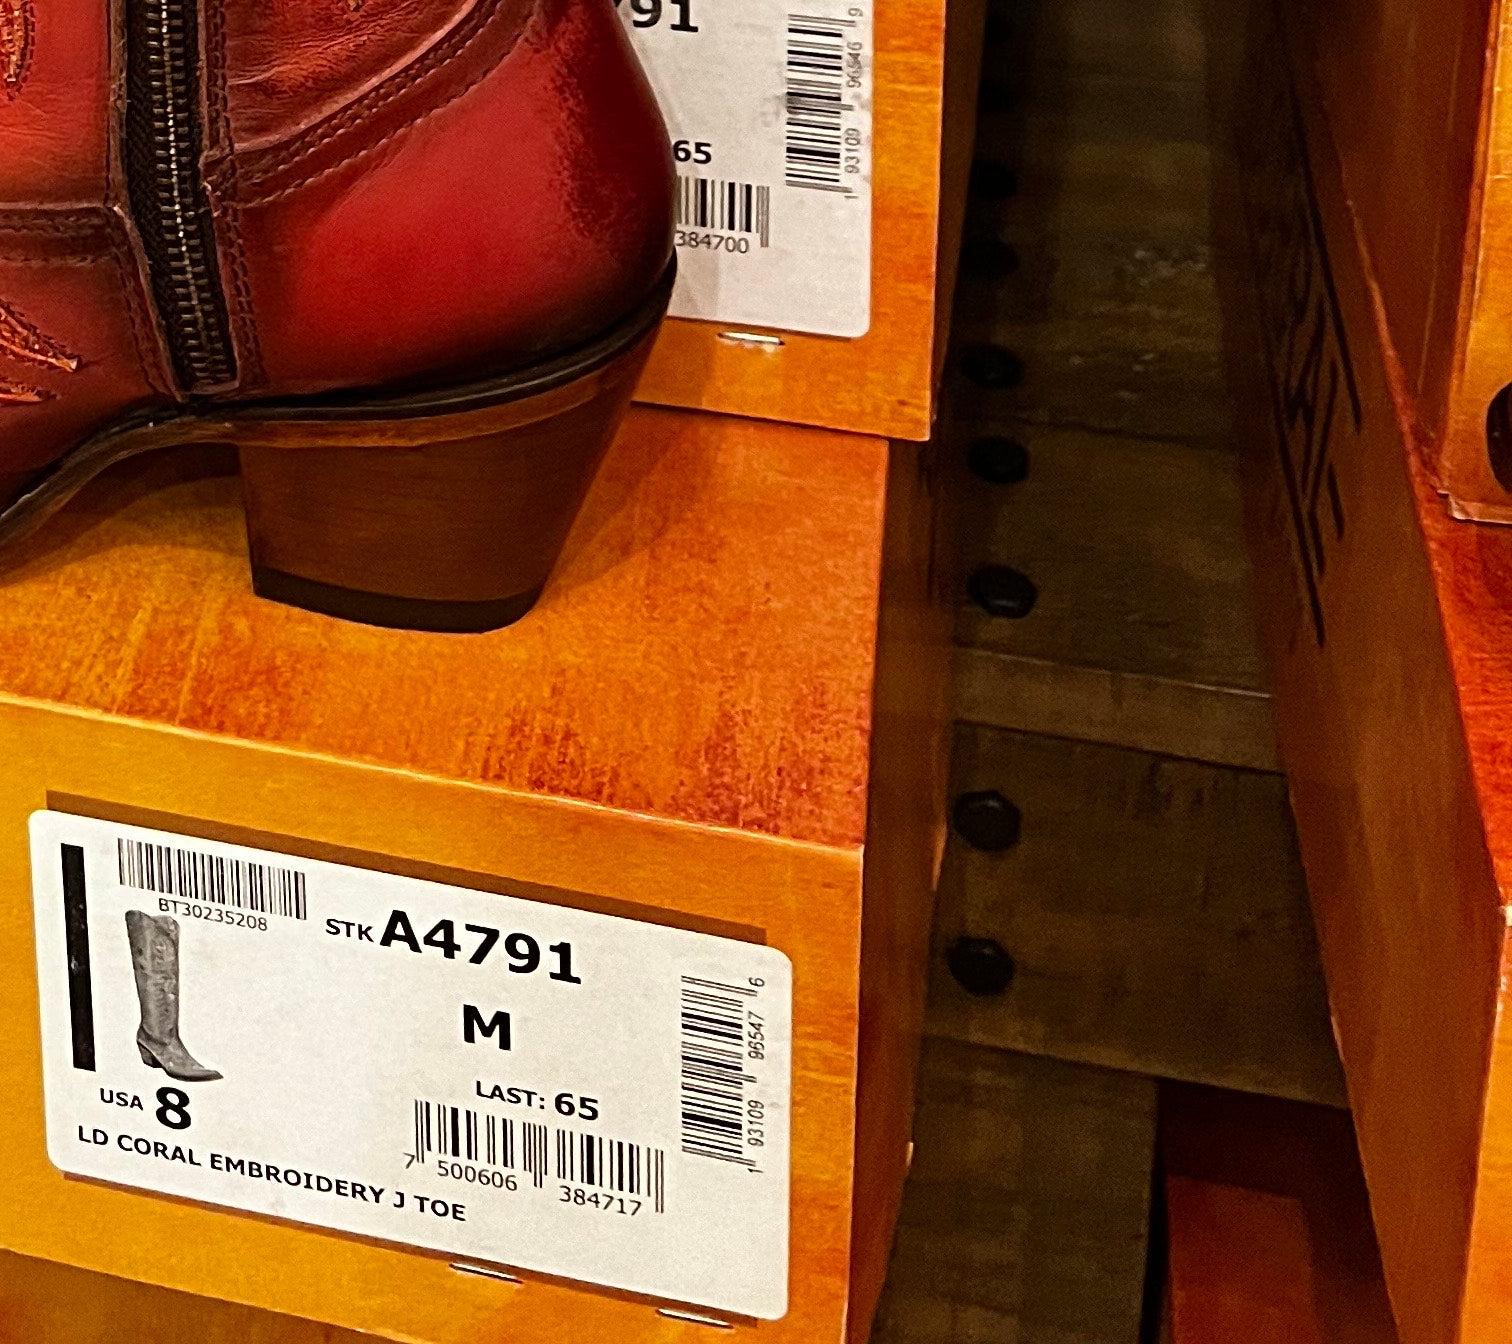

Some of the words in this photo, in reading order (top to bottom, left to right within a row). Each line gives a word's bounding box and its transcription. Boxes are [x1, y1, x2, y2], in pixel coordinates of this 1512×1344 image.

[672, 140, 712, 165] 65
[844, 128, 860, 173] 93109
[676, 230, 750, 254] 384700
[158, 898, 268, 932] BT30235208
[325, 918, 375, 943] STK
[379, 909, 582, 985] A4791
[749, 976, 766, 988] 6
[462, 1004, 512, 1051] M
[747, 1010, 765, 1060] 96547
[100, 1088, 144, 1112] USA
[155, 1086, 192, 1130] 8
[475, 1080, 546, 1110] LAST:
[553, 1092, 600, 1121] 65
[747, 1100, 764, 1147] 93109
[78, 1125, 109, 1145] LD
[118, 1134, 202, 1166] CORAL
[210, 1153, 385, 1204] EMBROIDERY
[393, 1191, 406, 1208] J
[414, 1195, 467, 1222] TOE
[402, 1153, 417, 1170] 7
[437, 1159, 518, 1192] 500606
[559, 1185, 642, 1217] 384717
